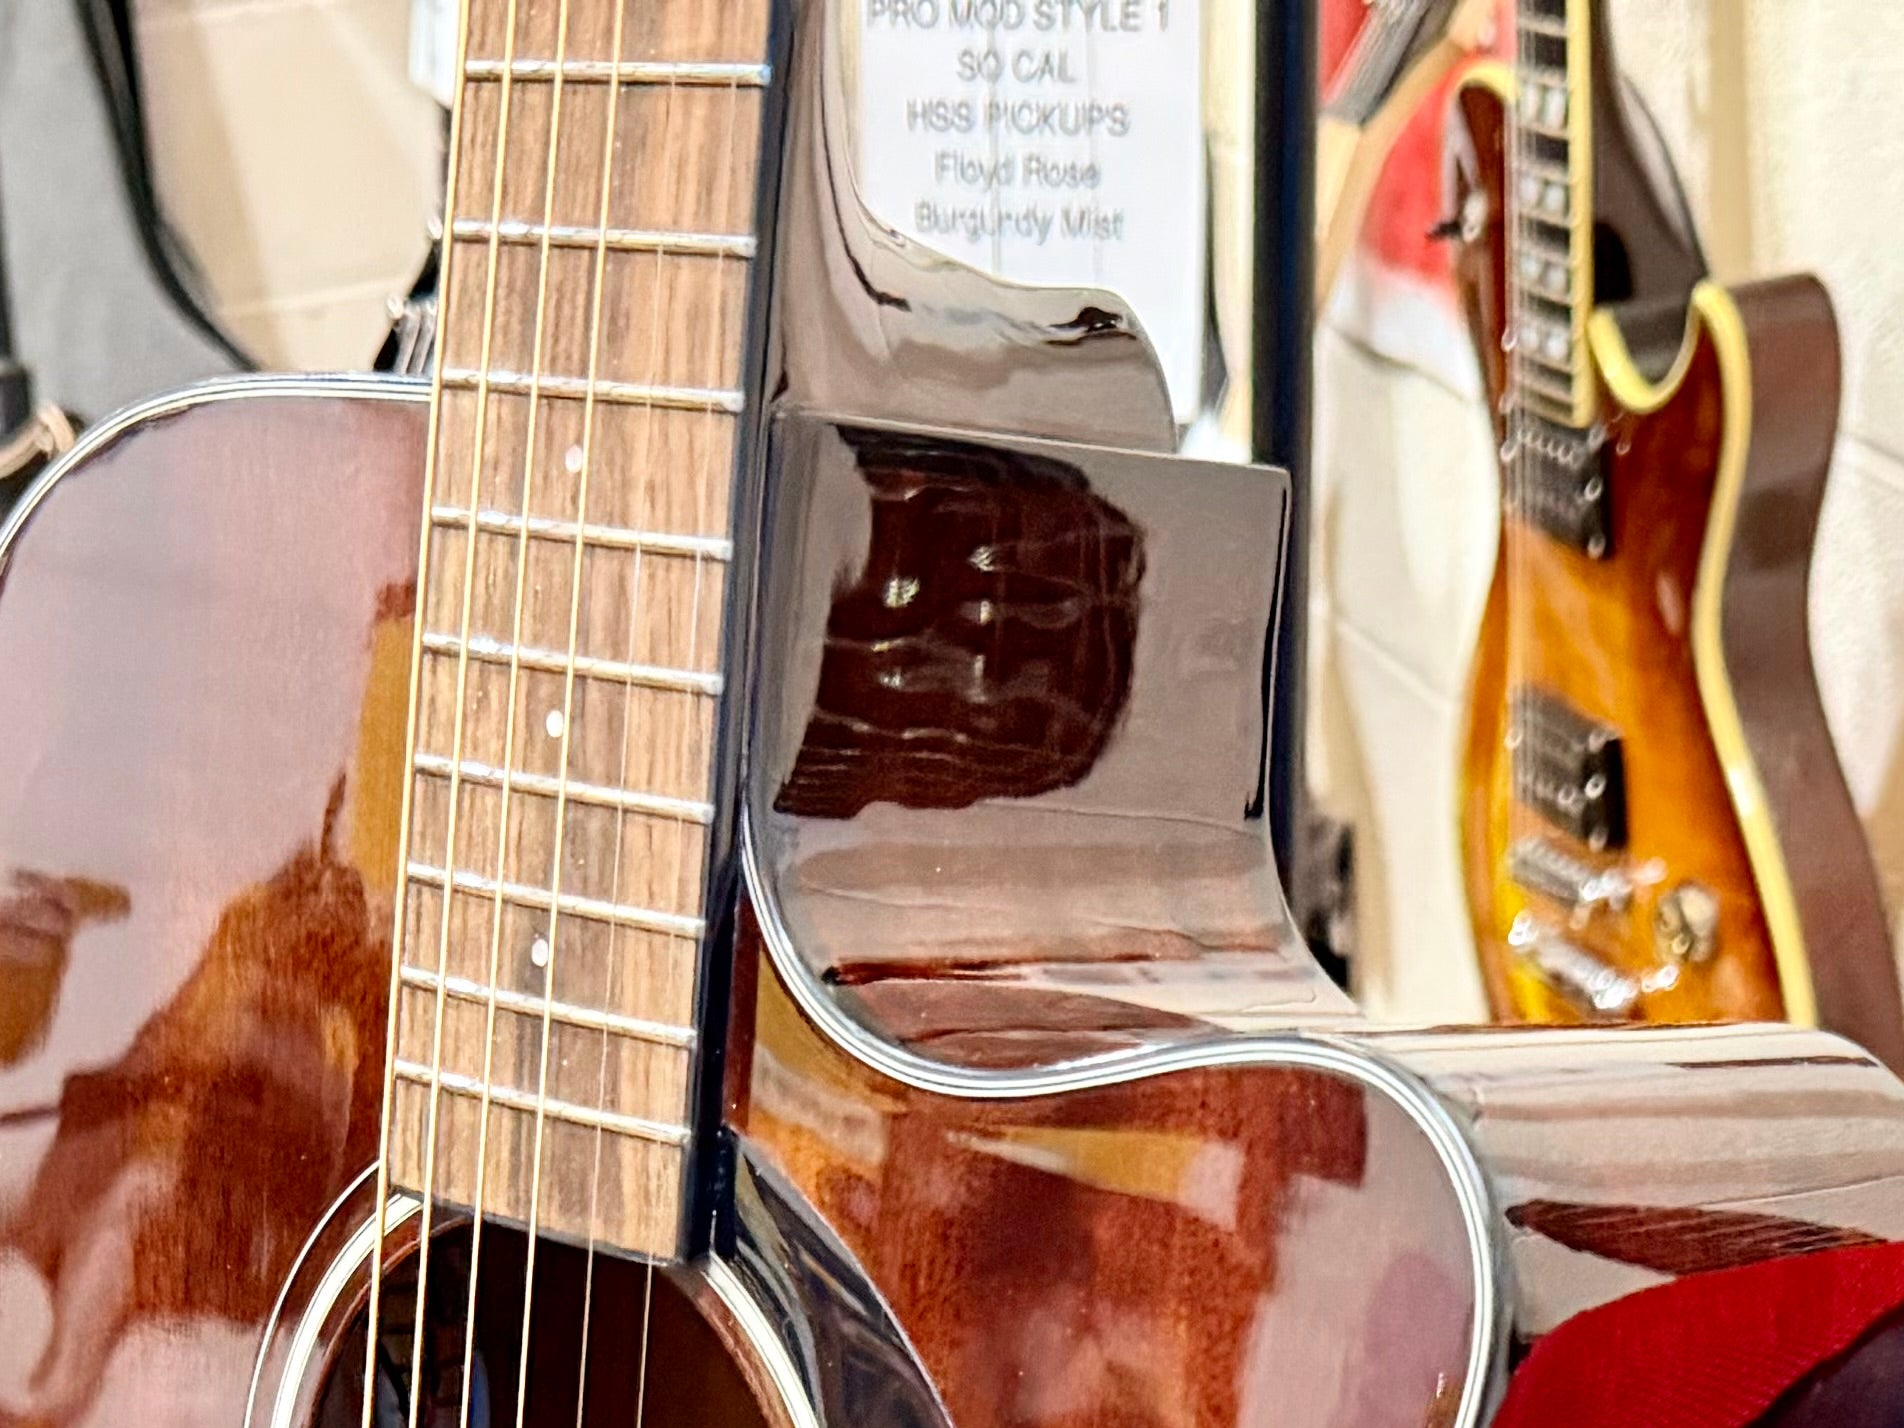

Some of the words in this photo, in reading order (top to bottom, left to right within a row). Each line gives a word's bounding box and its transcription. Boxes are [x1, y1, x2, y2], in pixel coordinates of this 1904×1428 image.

[866, 0, 938, 30] PRO
[949, 0, 1024, 31] MOD
[1033, 0, 1141, 32] STYLE
[1012, 49, 1078, 84] CAL
[906, 98, 974, 132] HSS
[985, 99, 1132, 138] PICKUPS
[934, 149, 1014, 193] Floyd
[1022, 153, 1102, 190] Rose
[1061, 203, 1126, 241] Mist
